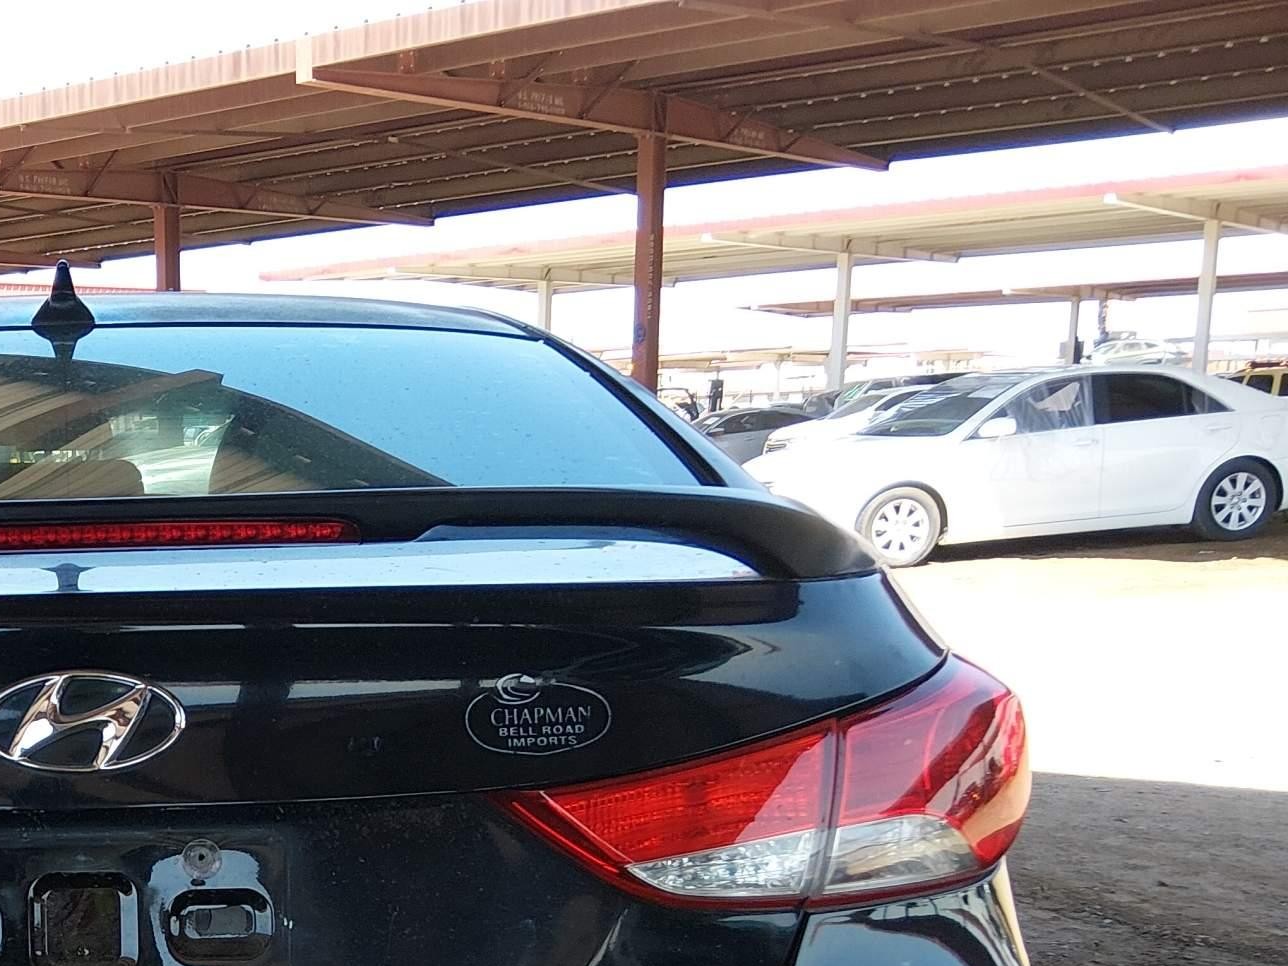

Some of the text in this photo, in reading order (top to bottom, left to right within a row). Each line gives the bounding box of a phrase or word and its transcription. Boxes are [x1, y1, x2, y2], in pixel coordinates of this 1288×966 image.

[490, 705, 591, 727] CHAPMAN
[498, 724, 585, 737] BELL ROAD
[508, 735, 577, 747] IMPORTS
